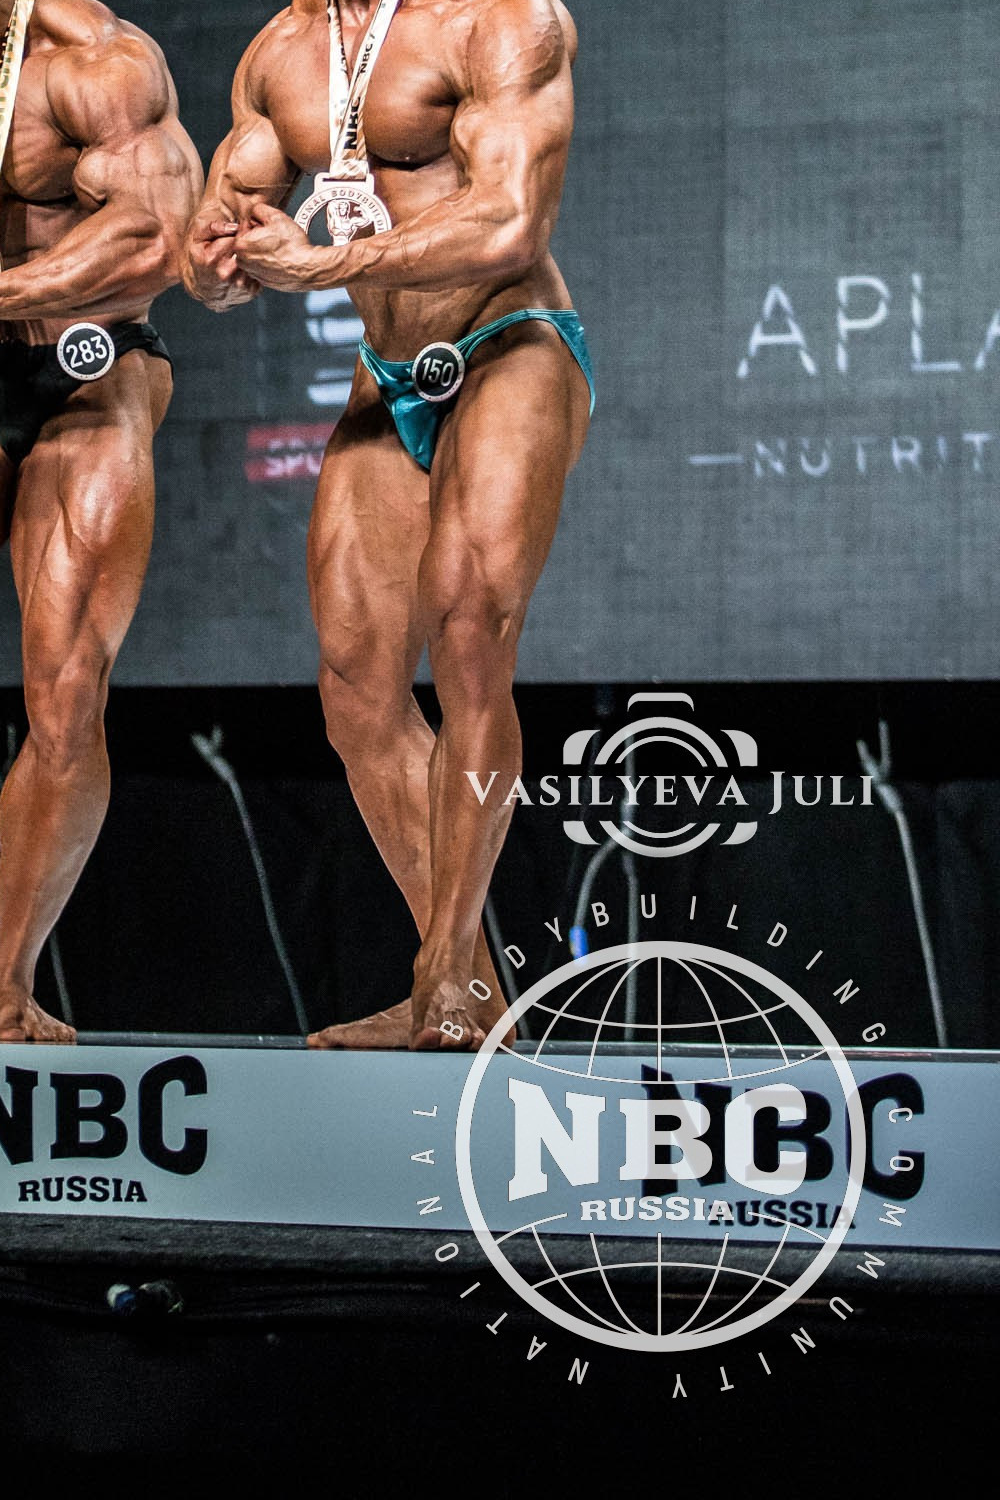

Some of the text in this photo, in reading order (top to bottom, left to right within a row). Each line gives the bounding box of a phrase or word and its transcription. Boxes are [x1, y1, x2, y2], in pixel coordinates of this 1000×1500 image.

[65, 335, 107, 369] 283
[422, 357, 455, 387] 150
[18, 1175, 148, 1203] RUSSIA
[708, 1199, 857, 1230] RUSSIA
